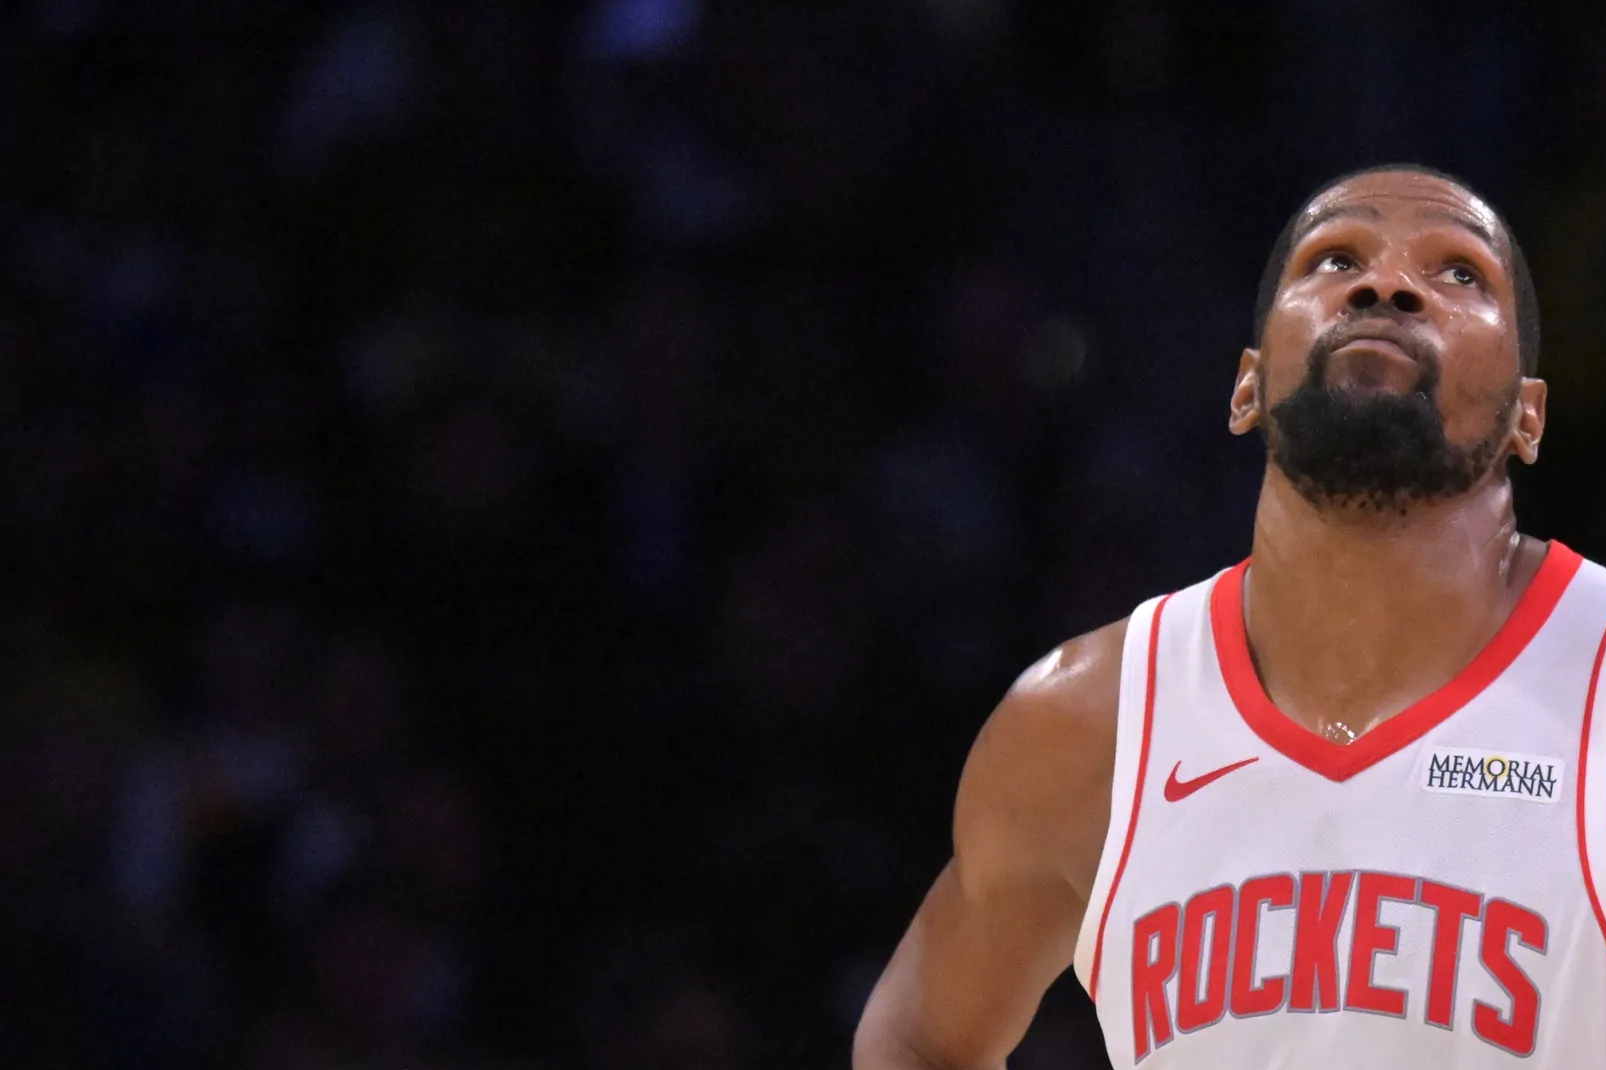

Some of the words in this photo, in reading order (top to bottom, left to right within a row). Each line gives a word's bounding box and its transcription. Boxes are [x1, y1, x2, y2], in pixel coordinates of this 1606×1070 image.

[1428, 753, 1557, 783] MEMORIAL
[1427, 769, 1555, 798] HERMANN
[1131, 869, 1549, 1065] ROCKETS
